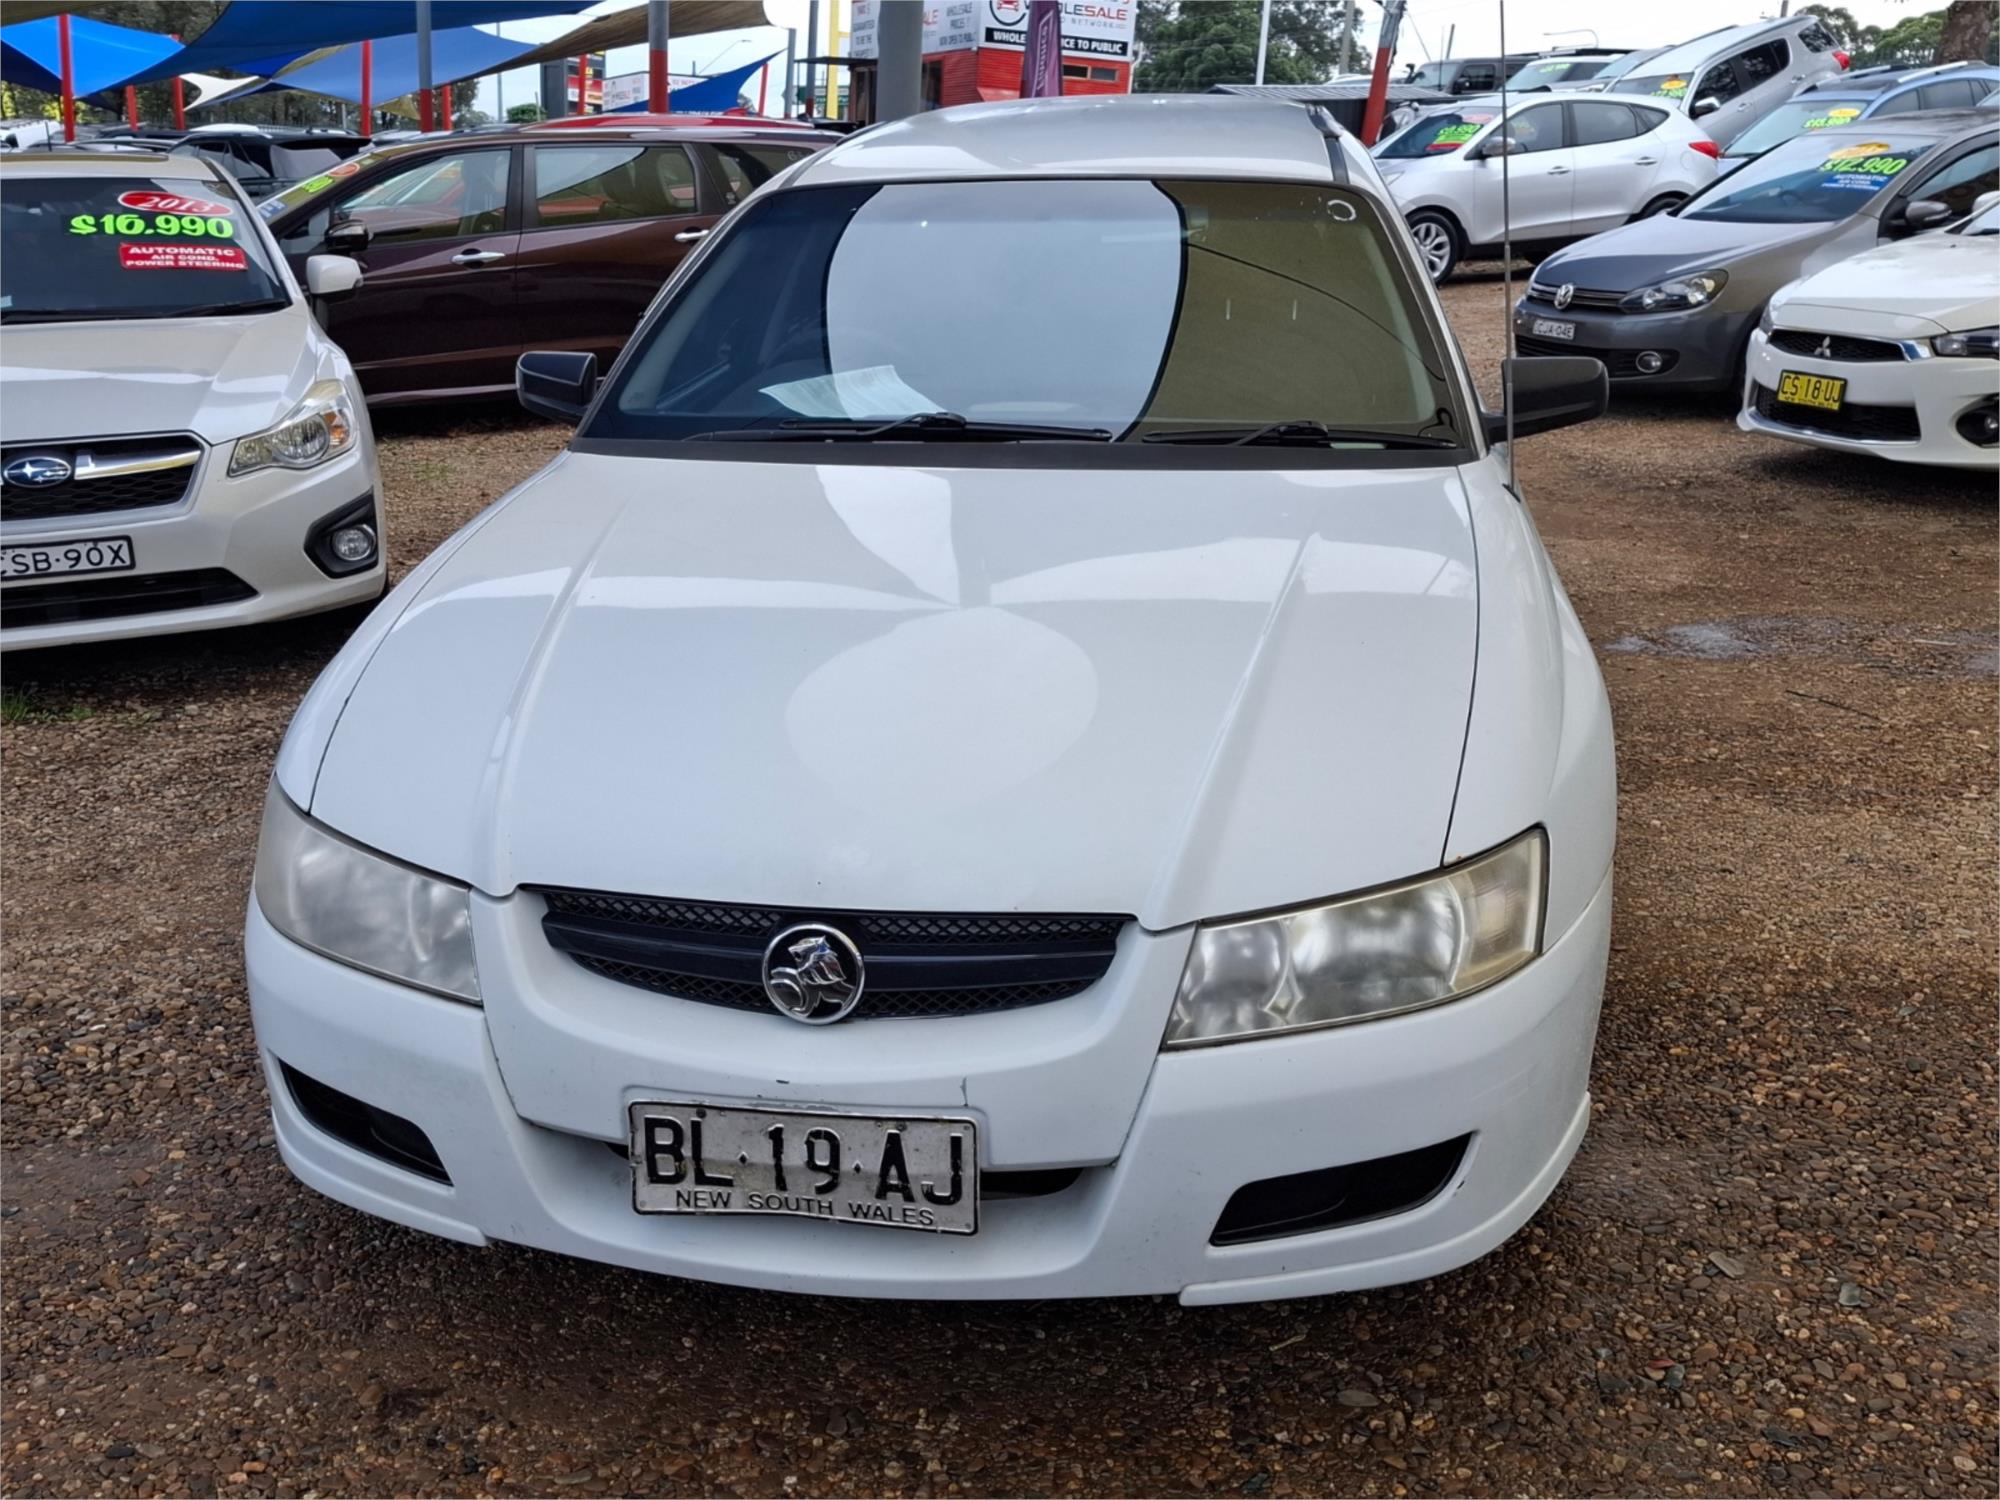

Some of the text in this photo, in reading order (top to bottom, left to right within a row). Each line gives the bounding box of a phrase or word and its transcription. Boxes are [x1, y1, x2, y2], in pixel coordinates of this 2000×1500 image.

[993, 30, 1026, 44] WHOLE
[1077, 39, 1089, 49] TO
[1091, 41, 1123, 53] PUBLIC
[137, 196, 215, 213] 2013
[128, 246, 236, 257] AUTOMATIC
[125, 259, 176, 267] POWER
[675, 1189, 935, 1227] NEW SOUTH WALES
